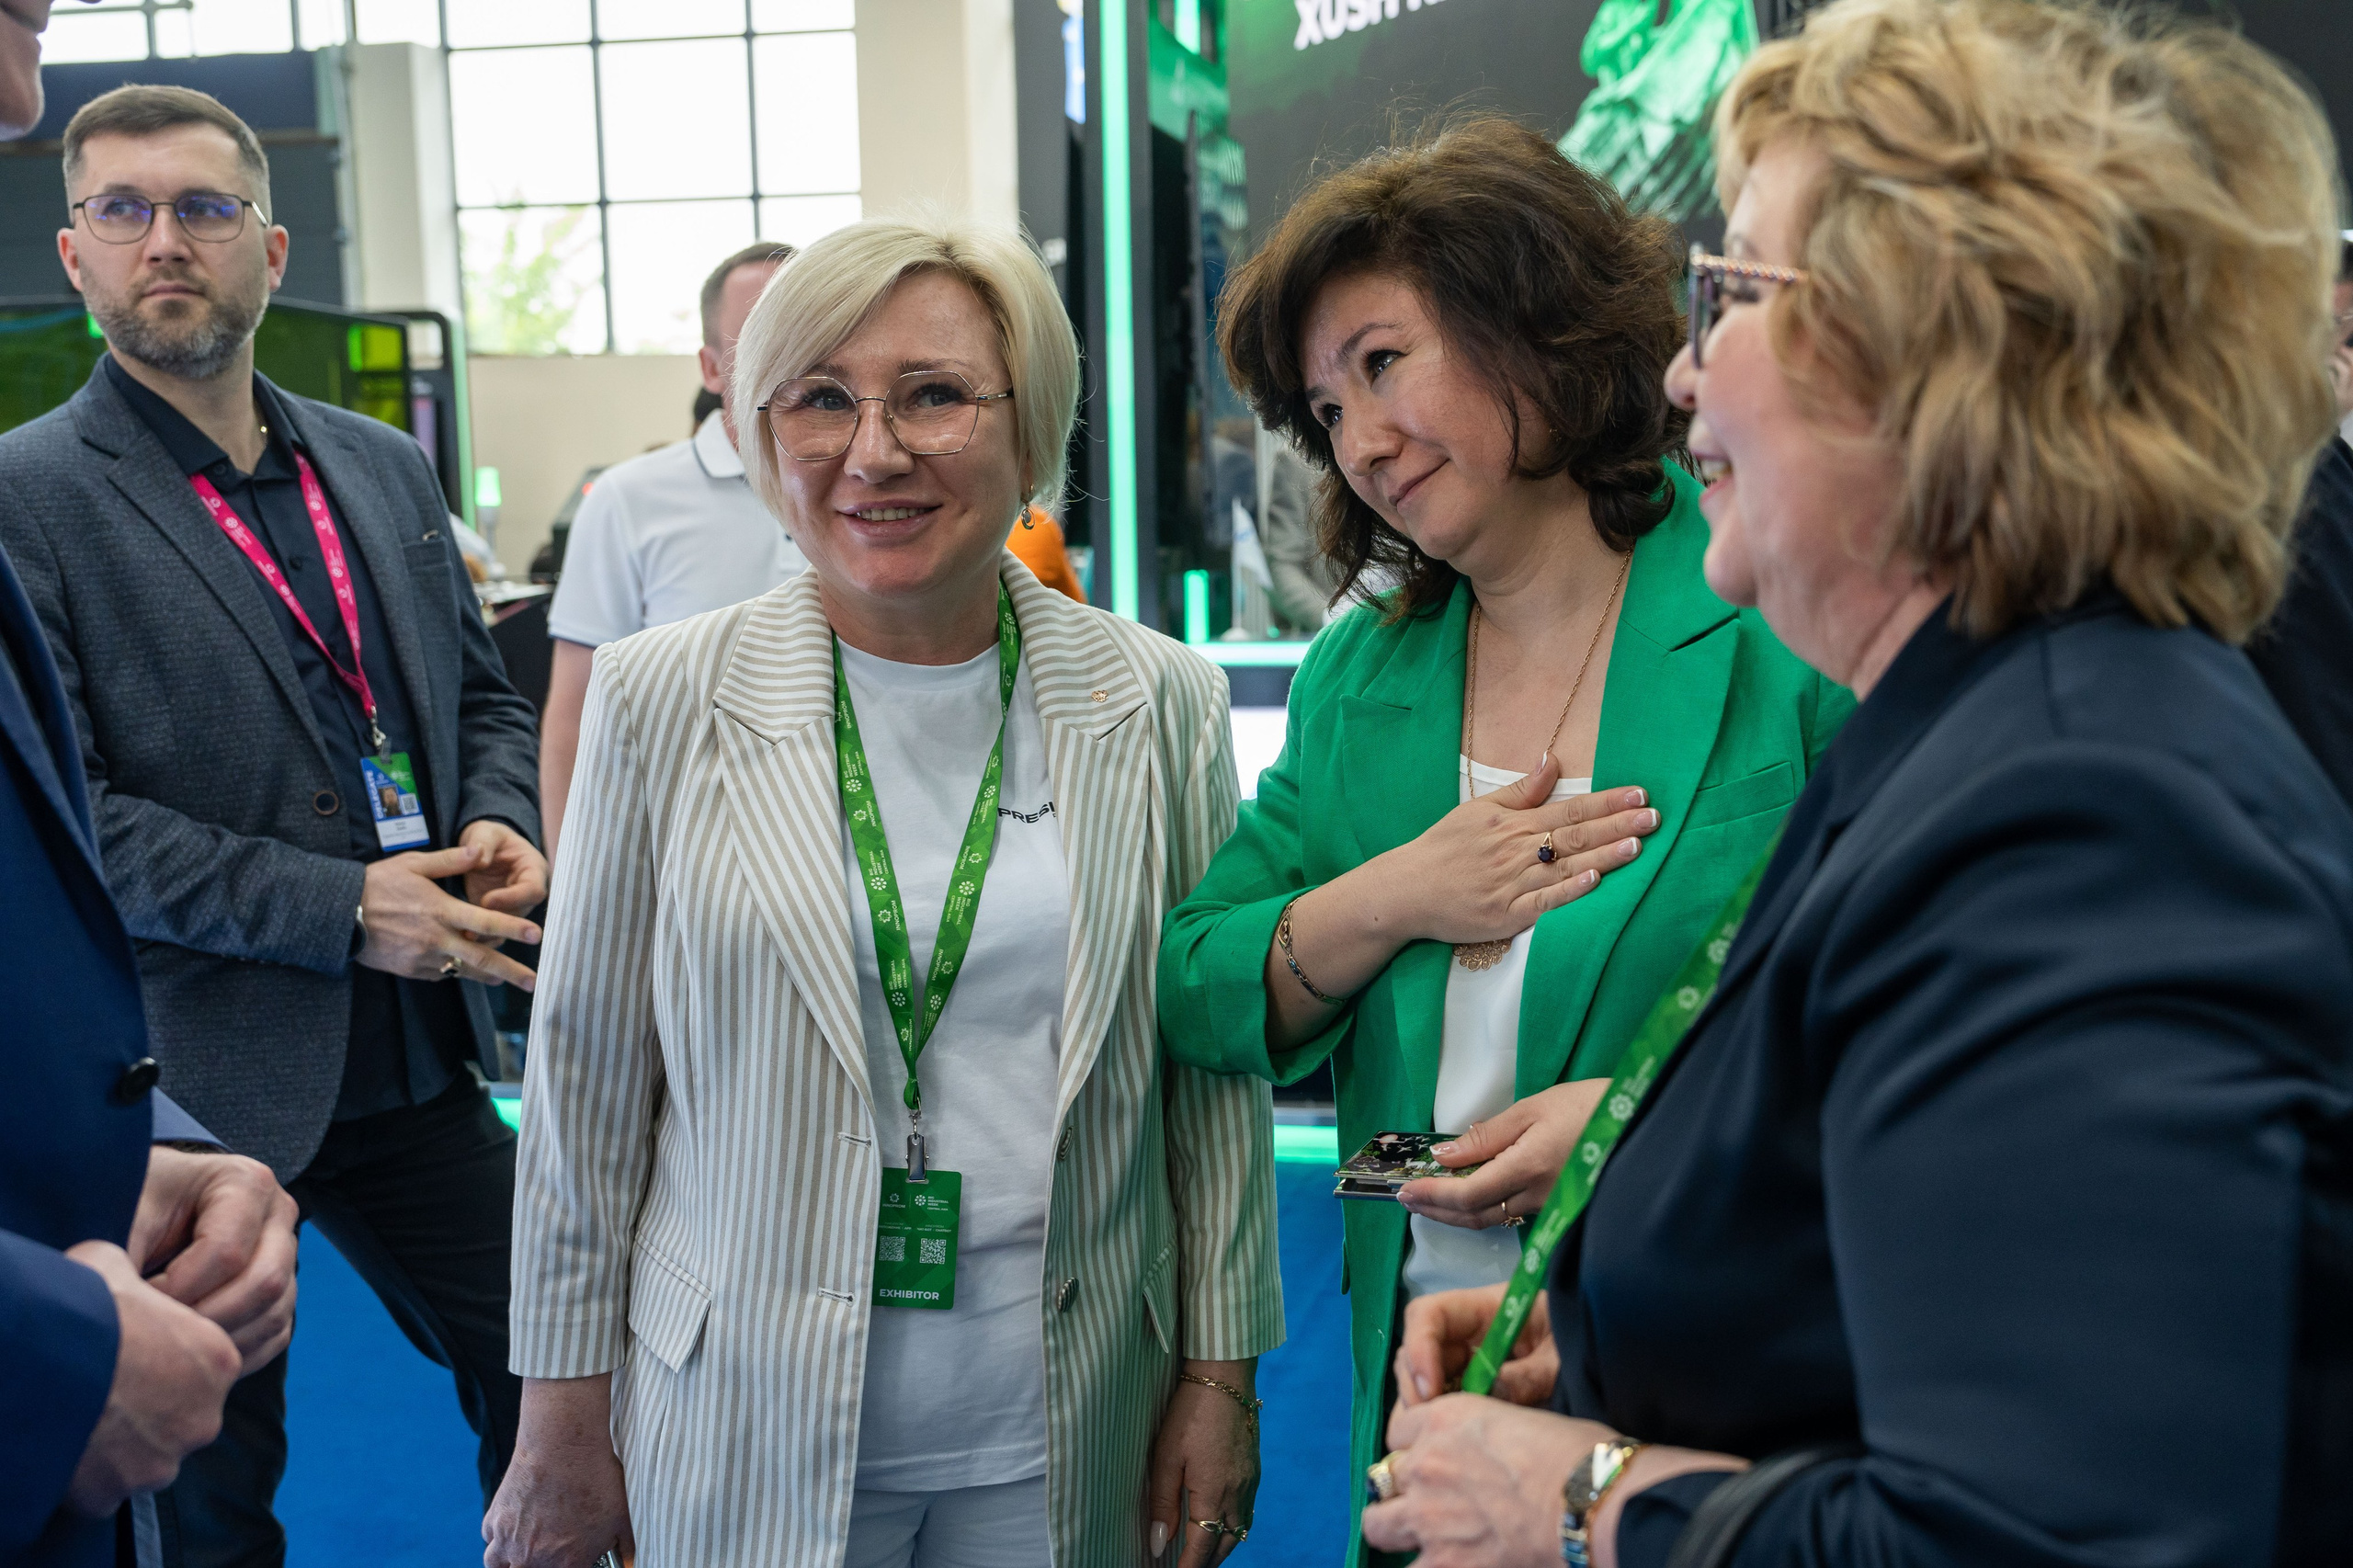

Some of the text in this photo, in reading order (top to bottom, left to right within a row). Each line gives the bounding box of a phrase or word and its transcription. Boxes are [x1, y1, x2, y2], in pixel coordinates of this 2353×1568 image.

[840, 700, 852, 729] INNOPROM
[866, 800, 877, 827] INNOPROM
[960, 845, 971, 869] INNOPROM
[891, 900, 901, 931] INNOPROM
[931, 949, 944, 981] INNOPROM
[879, 1289, 939, 1301] EXHIBITOR
